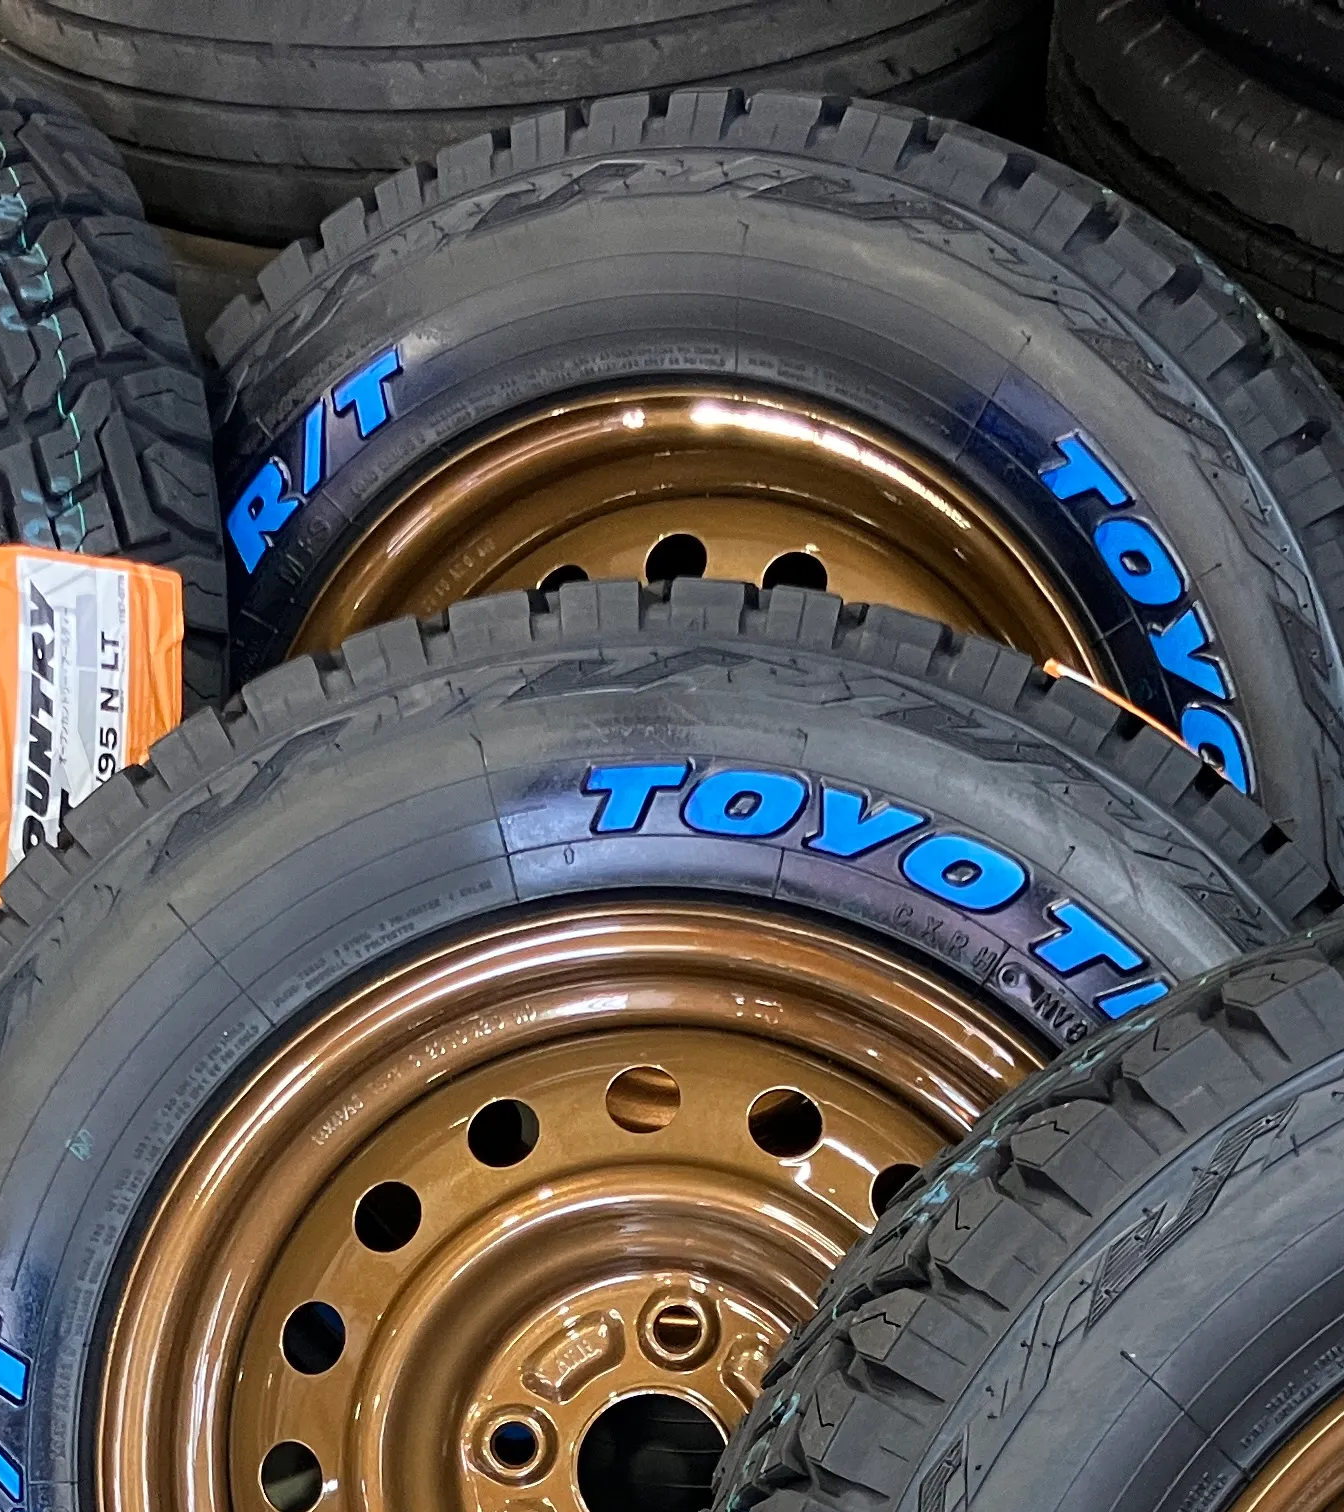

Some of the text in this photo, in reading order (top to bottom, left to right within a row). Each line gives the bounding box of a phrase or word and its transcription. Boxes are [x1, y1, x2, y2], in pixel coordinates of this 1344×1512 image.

[224, 350, 401, 576] R/T
[19, 573, 53, 851] OUNTRY
[99, 687, 121, 713] N
[100, 631, 119, 671] LT
[585, 760, 1027, 913] TOYO
